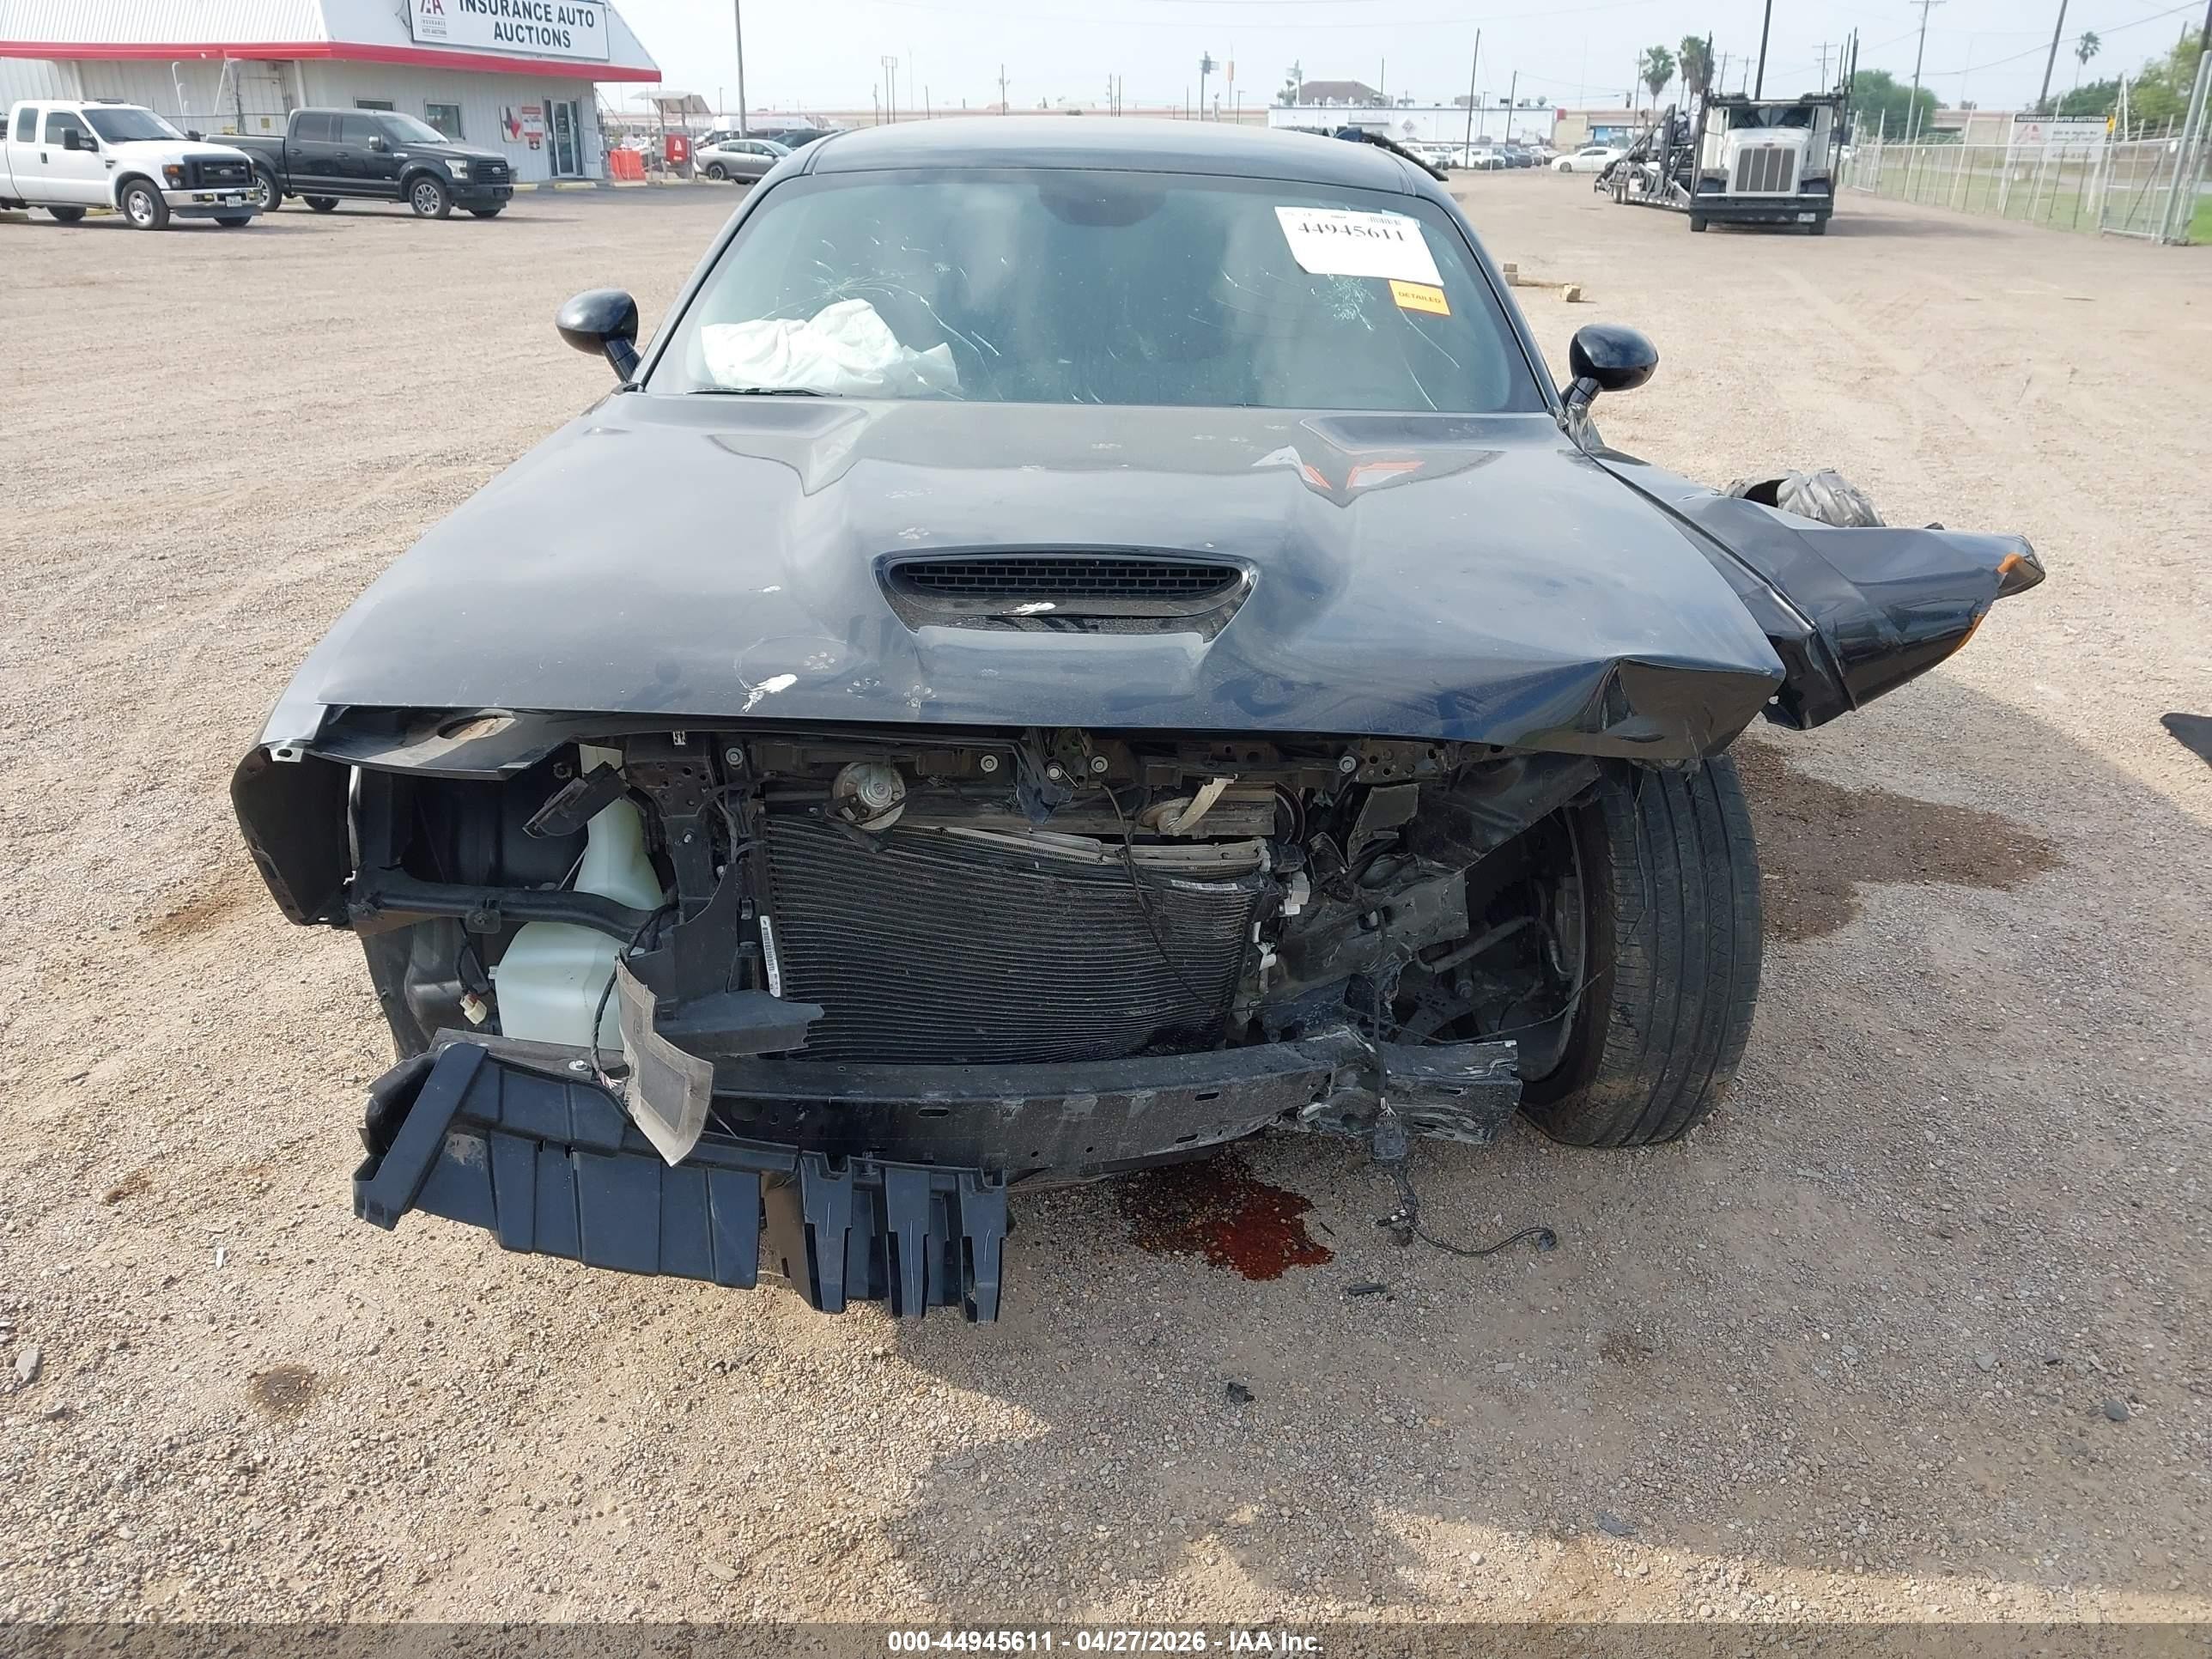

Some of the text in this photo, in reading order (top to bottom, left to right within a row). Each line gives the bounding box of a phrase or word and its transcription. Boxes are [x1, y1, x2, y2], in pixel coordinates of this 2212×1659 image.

[459, 0, 595, 28] INSURANCE AUTO
[494, 21, 571, 48] AUCTIONS
[1297, 222, 1405, 241] 44945611
[1398, 291, 1442, 304] DETAILED
